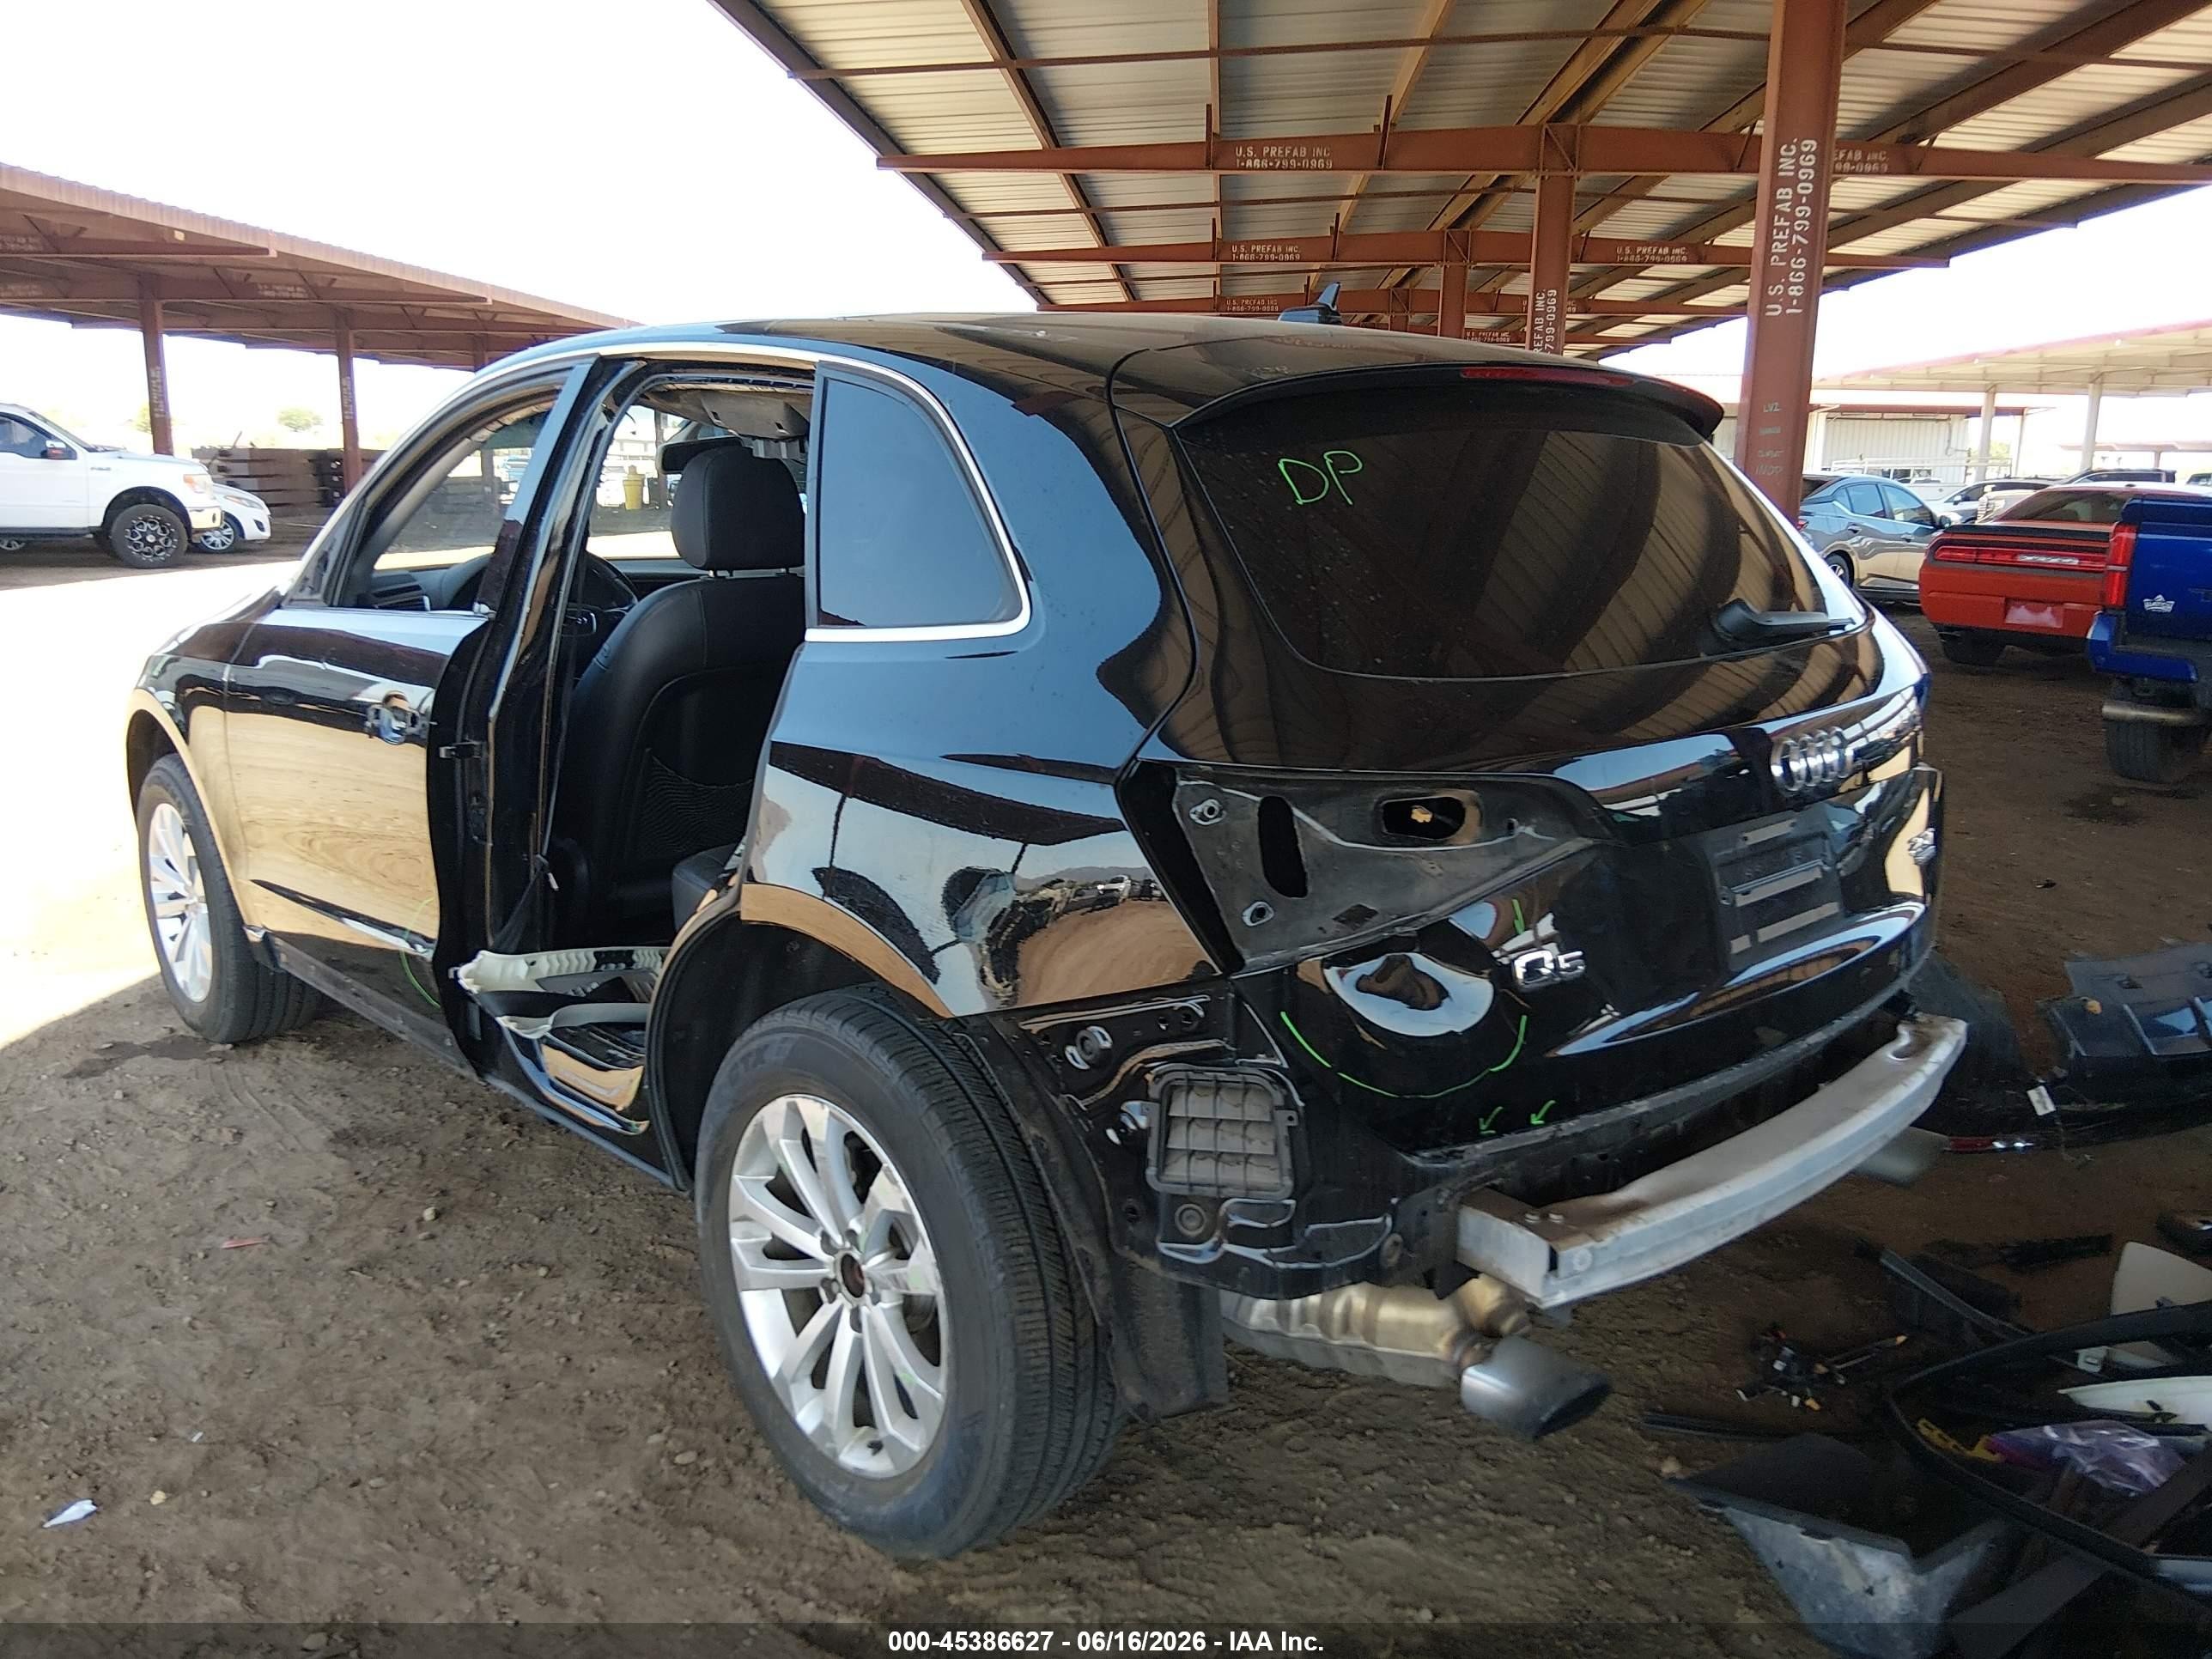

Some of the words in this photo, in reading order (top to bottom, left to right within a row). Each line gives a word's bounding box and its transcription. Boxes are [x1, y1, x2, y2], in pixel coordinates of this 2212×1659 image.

[1236, 146, 1256, 157] U.S.
[1262, 146, 1307, 158] PREFAB
[1237, 159, 1333, 169] 1-866-799-0969
[1778, 137, 1798, 177] INC.
[1771, 187, 1793, 266] PREFAB
[1786, 139, 1817, 314] 1-866-799-0969
[1251, 244, 1282, 253] PREFAB
[1636, 246, 1669, 255] PREFAB
[1535, 289, 1546, 311] INC.
[1765, 278, 1785, 316] U.S.
[1533, 317, 1544, 353] REFAB
[1545, 289, 1558, 356] -799-0969
[1277, 450, 1364, 506] DP
[1512, 950, 1587, 990] Q5
